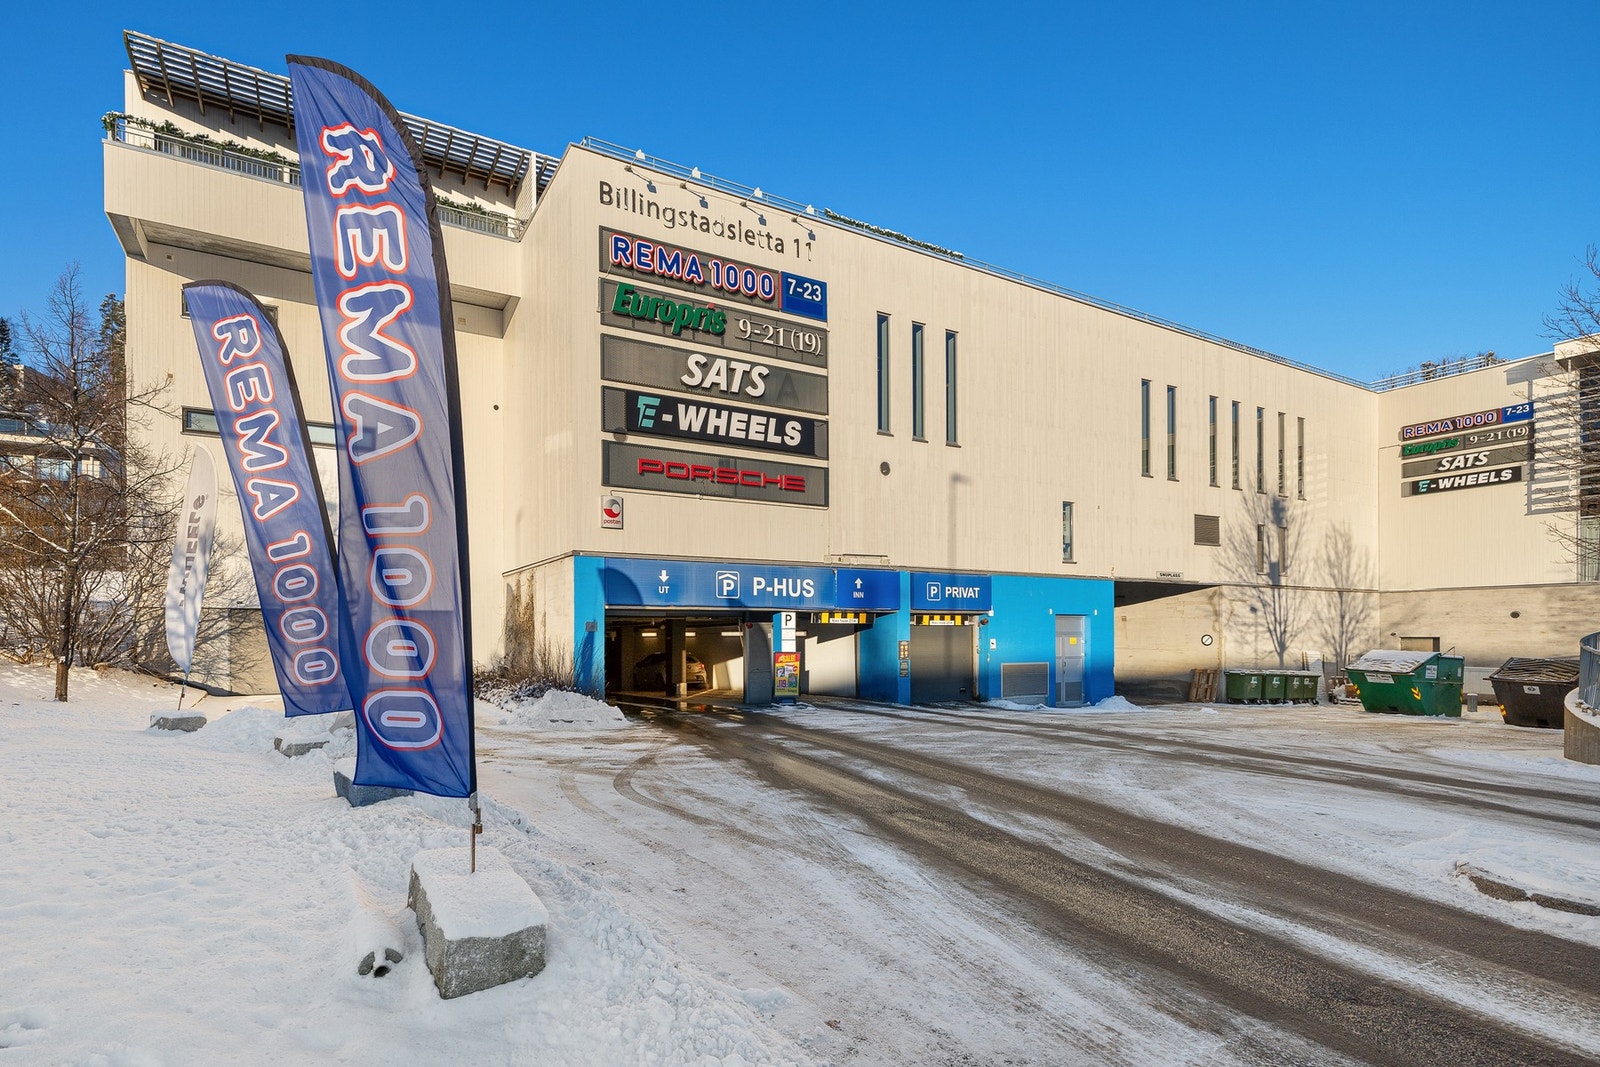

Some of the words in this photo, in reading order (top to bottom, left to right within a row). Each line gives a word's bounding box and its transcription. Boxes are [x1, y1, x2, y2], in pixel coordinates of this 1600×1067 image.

[599, 180, 785, 254] Billingstadsletta
[794, 238, 813, 261] 11
[609, 232, 704, 284] REMA
[709, 258, 775, 300] 1000
[319, 121, 424, 467] REMA
[787, 278, 822, 301] 7-23
[612, 282, 726, 335] Europris
[738, 317, 785, 348] 9-21
[790, 329, 822, 356] (19)
[681, 353, 770, 397] SATS
[1506, 404, 1530, 416] 7-23
[1404, 422, 1453, 438] REMA
[1455, 411, 1497, 429] 1000
[1469, 431, 1503, 444] 9-21
[1437, 451, 1490, 471] SATS
[638, 458, 806, 492] PORSCHE
[211, 313, 301, 521] REMA
[265, 528, 341, 687] 1000
[658, 586, 670, 594] UT
[752, 577, 815, 598] P-HUS
[853, 591, 865, 599] INN
[930, 586, 938, 598] P
[945, 586, 980, 599] PRIVAT
[361, 491, 445, 752] 1000
[785, 614, 792, 626] P
